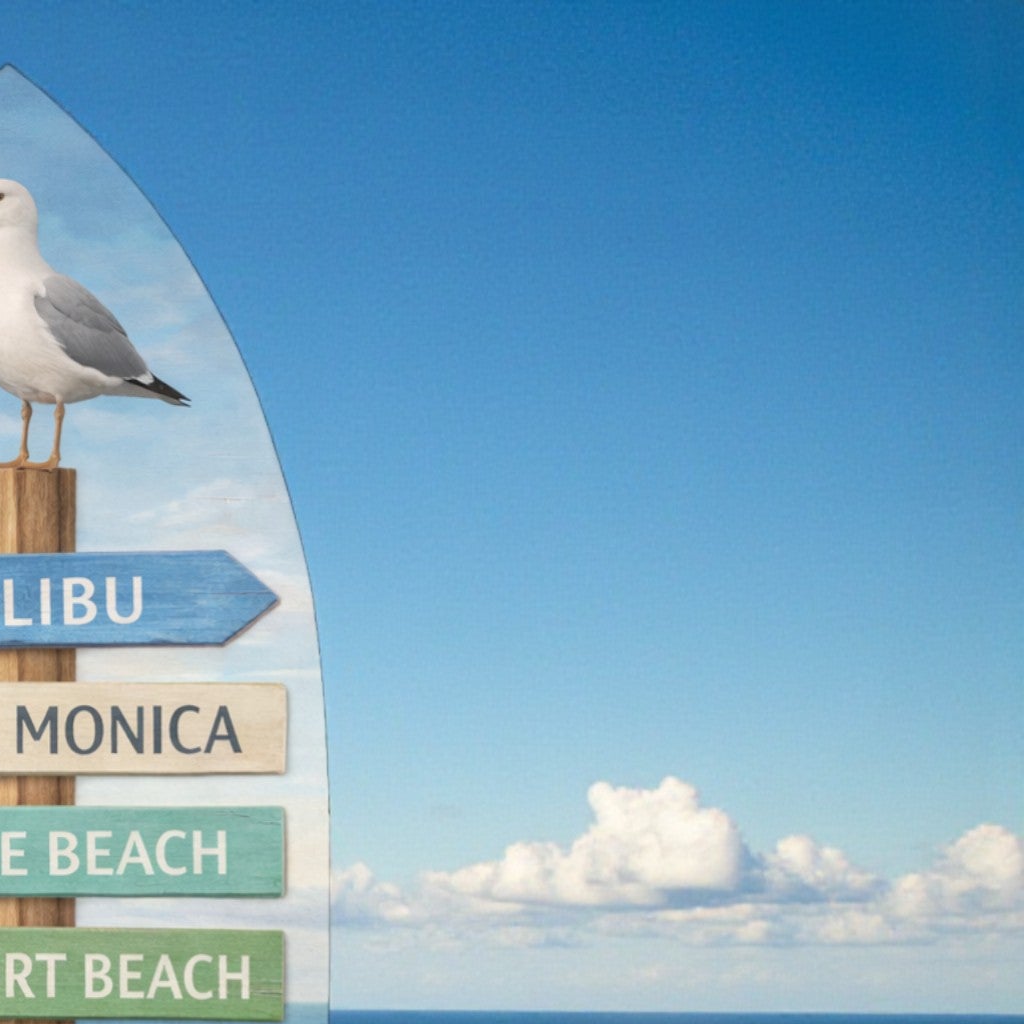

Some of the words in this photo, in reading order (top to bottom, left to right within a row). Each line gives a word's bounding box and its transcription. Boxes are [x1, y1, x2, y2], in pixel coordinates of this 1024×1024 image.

[15, 704, 242, 755] MONICA
[48, 829, 227, 877] BEACH
[84, 953, 251, 1001] BEACH
